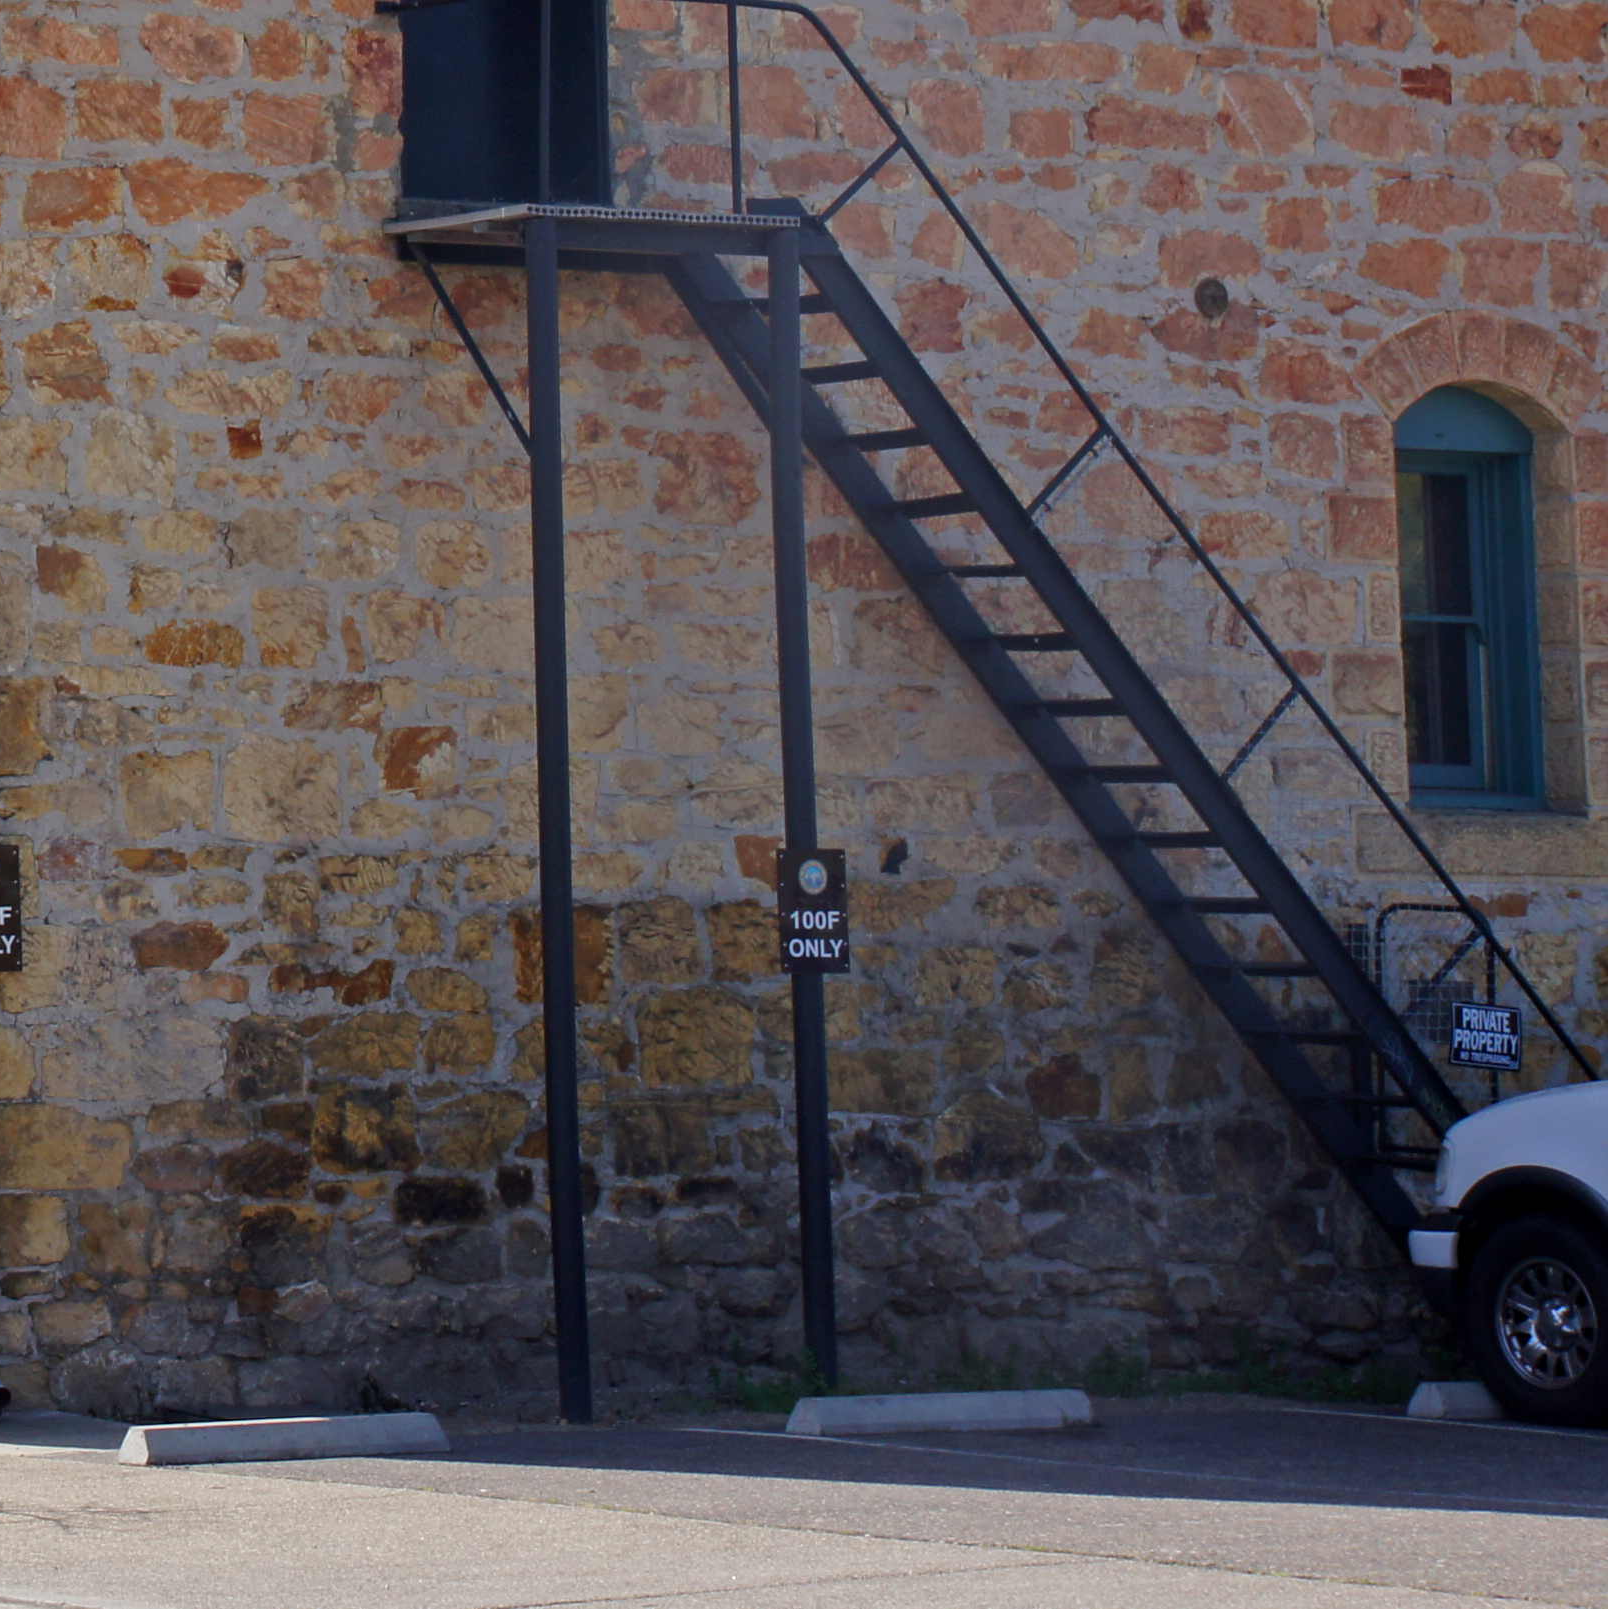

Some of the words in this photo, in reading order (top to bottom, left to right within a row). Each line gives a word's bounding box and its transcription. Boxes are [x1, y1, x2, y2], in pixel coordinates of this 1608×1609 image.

[790, 910, 840, 930] 100F
[789, 938, 843, 958] ONLY
[1462, 1007, 1512, 1033] PRIVATE
[1454, 1028, 1518, 1055] PROPERTY
